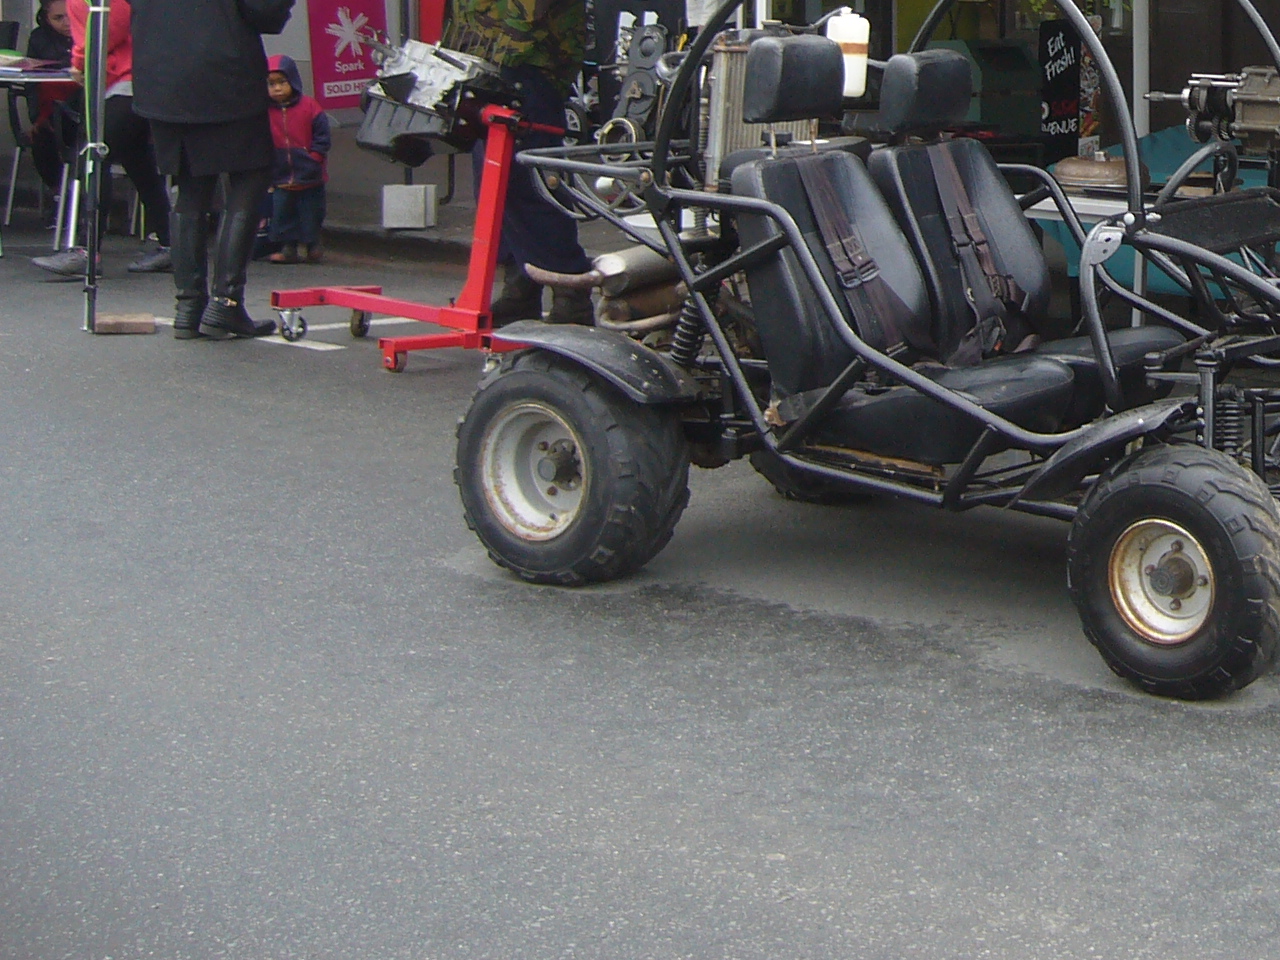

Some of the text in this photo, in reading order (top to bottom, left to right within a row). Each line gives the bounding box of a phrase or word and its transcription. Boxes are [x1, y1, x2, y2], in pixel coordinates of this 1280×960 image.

[1047, 31, 1066, 58] Eat
[335, 59, 365, 75] Spark
[1045, 46, 1076, 81] Fresh!
[326, 82, 352, 95] SOLD
